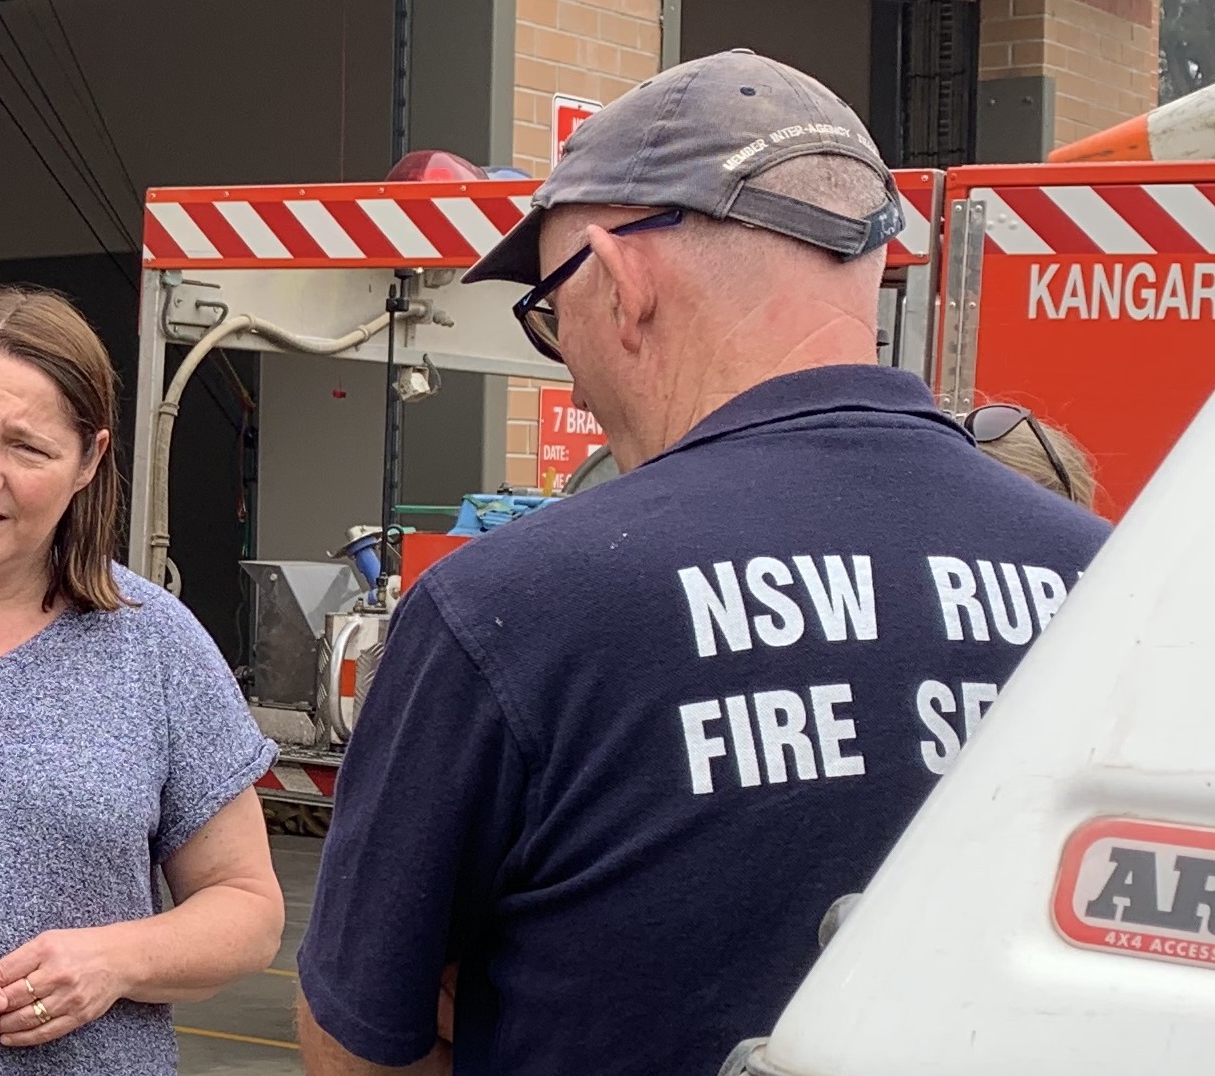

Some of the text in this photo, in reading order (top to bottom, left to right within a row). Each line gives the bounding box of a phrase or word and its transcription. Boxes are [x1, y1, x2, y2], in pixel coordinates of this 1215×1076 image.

[723, 138, 769, 171] MEMBER
[769, 123, 851, 143] INTER-AGENCY
[1028, 262, 1215, 321] KANGAR
[553, 406, 563, 432] 7
[544, 445, 570, 461] DATE:
[677, 555, 1085, 658] NSW RUR
[678, 683, 866, 795] FIRE
[1104, 931, 1142, 949] 4X4
